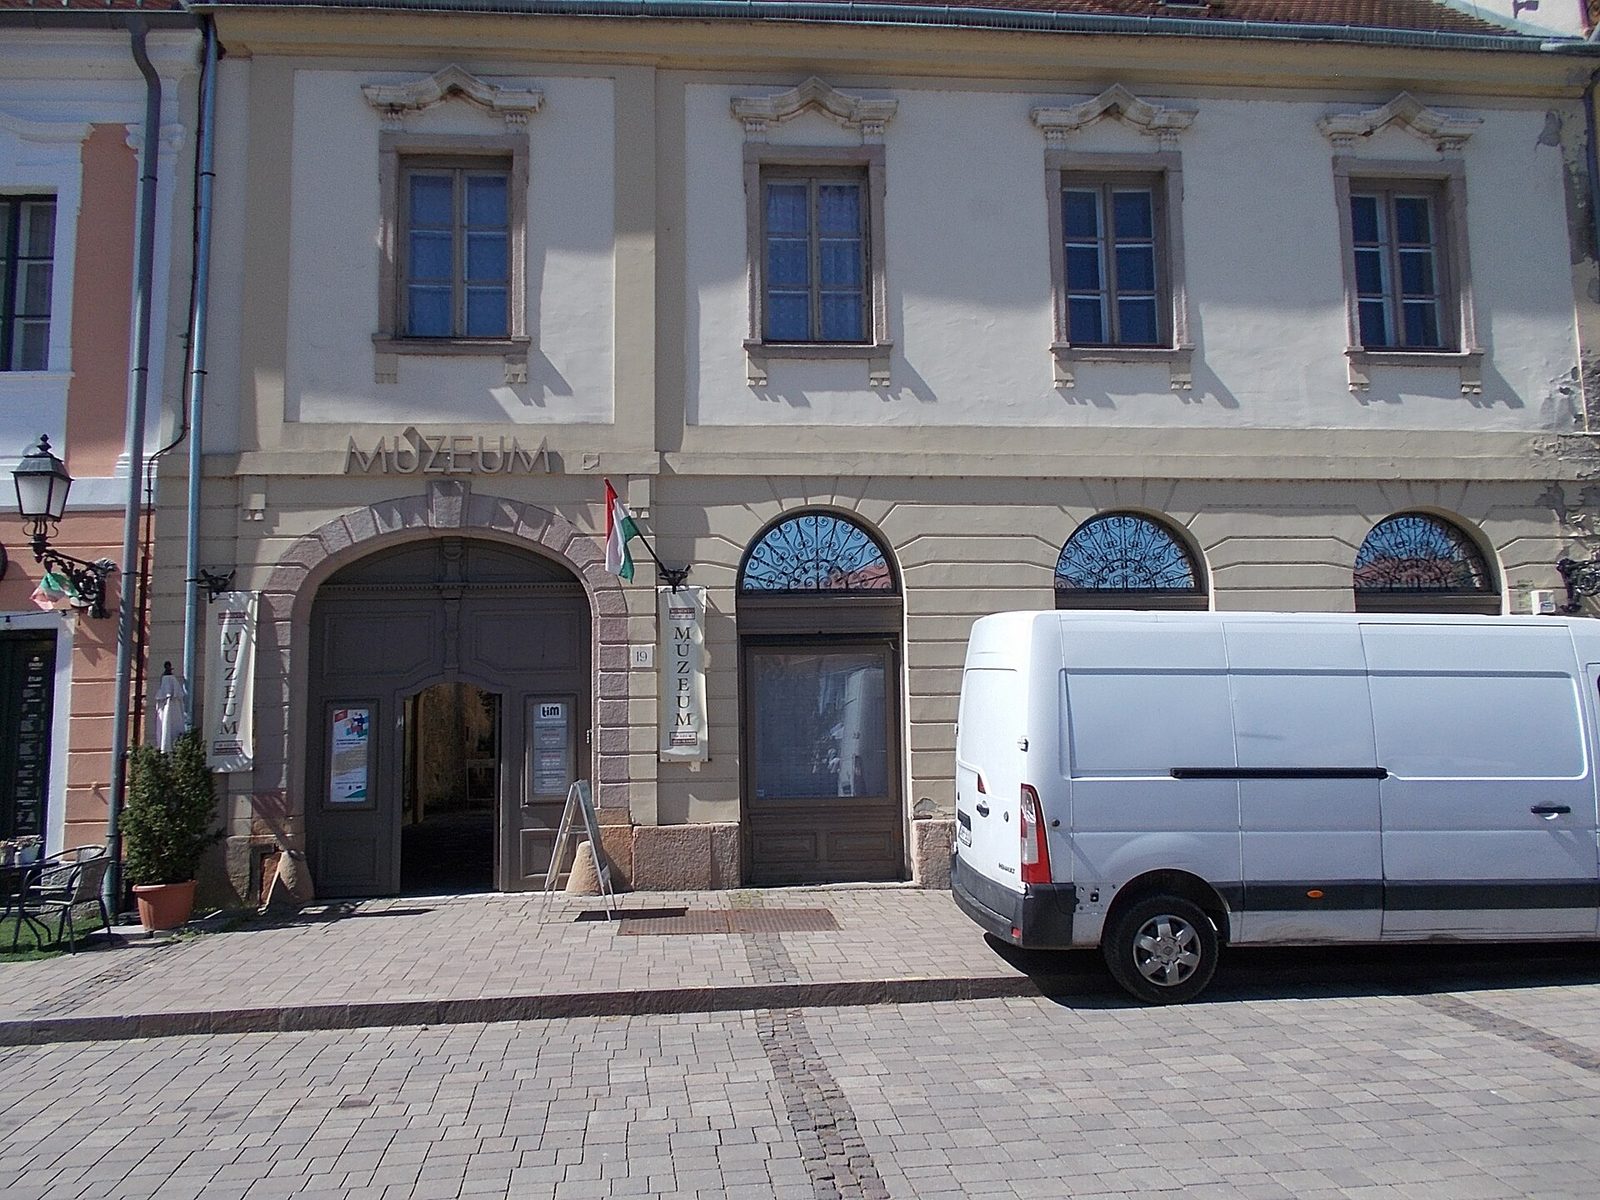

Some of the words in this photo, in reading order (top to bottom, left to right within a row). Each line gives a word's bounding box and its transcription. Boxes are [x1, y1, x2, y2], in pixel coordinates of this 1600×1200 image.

[636, 651, 648, 663] 19
[674, 626, 693, 726] MÚZEUM
[541, 706, 560, 717] tim
